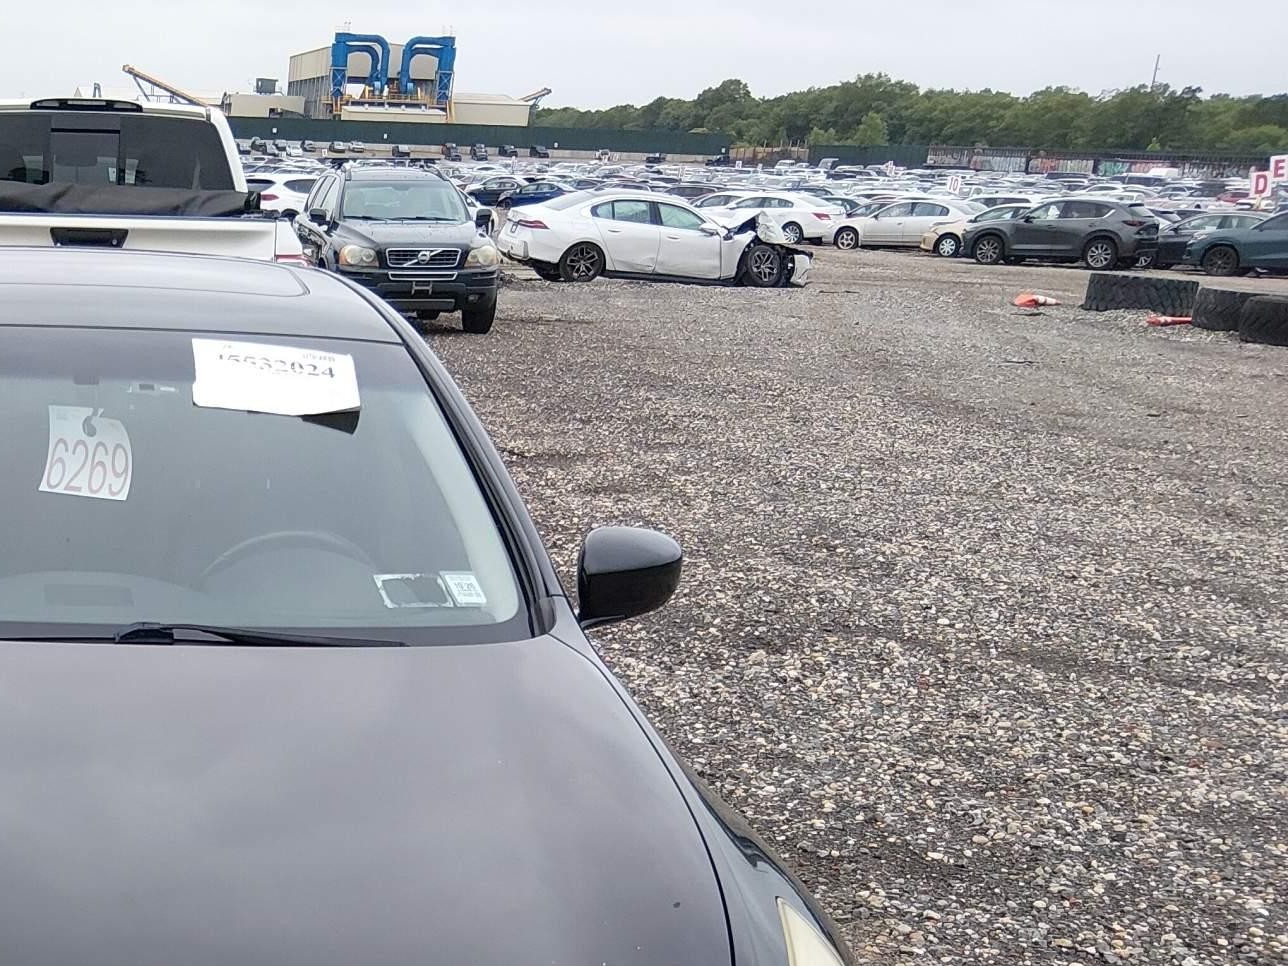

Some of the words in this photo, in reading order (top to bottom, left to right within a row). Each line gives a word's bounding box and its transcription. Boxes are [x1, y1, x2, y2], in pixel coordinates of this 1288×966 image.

[1274, 159, 1285, 178] E
[1254, 174, 1268, 194] D
[46, 437, 129, 497] 6269
